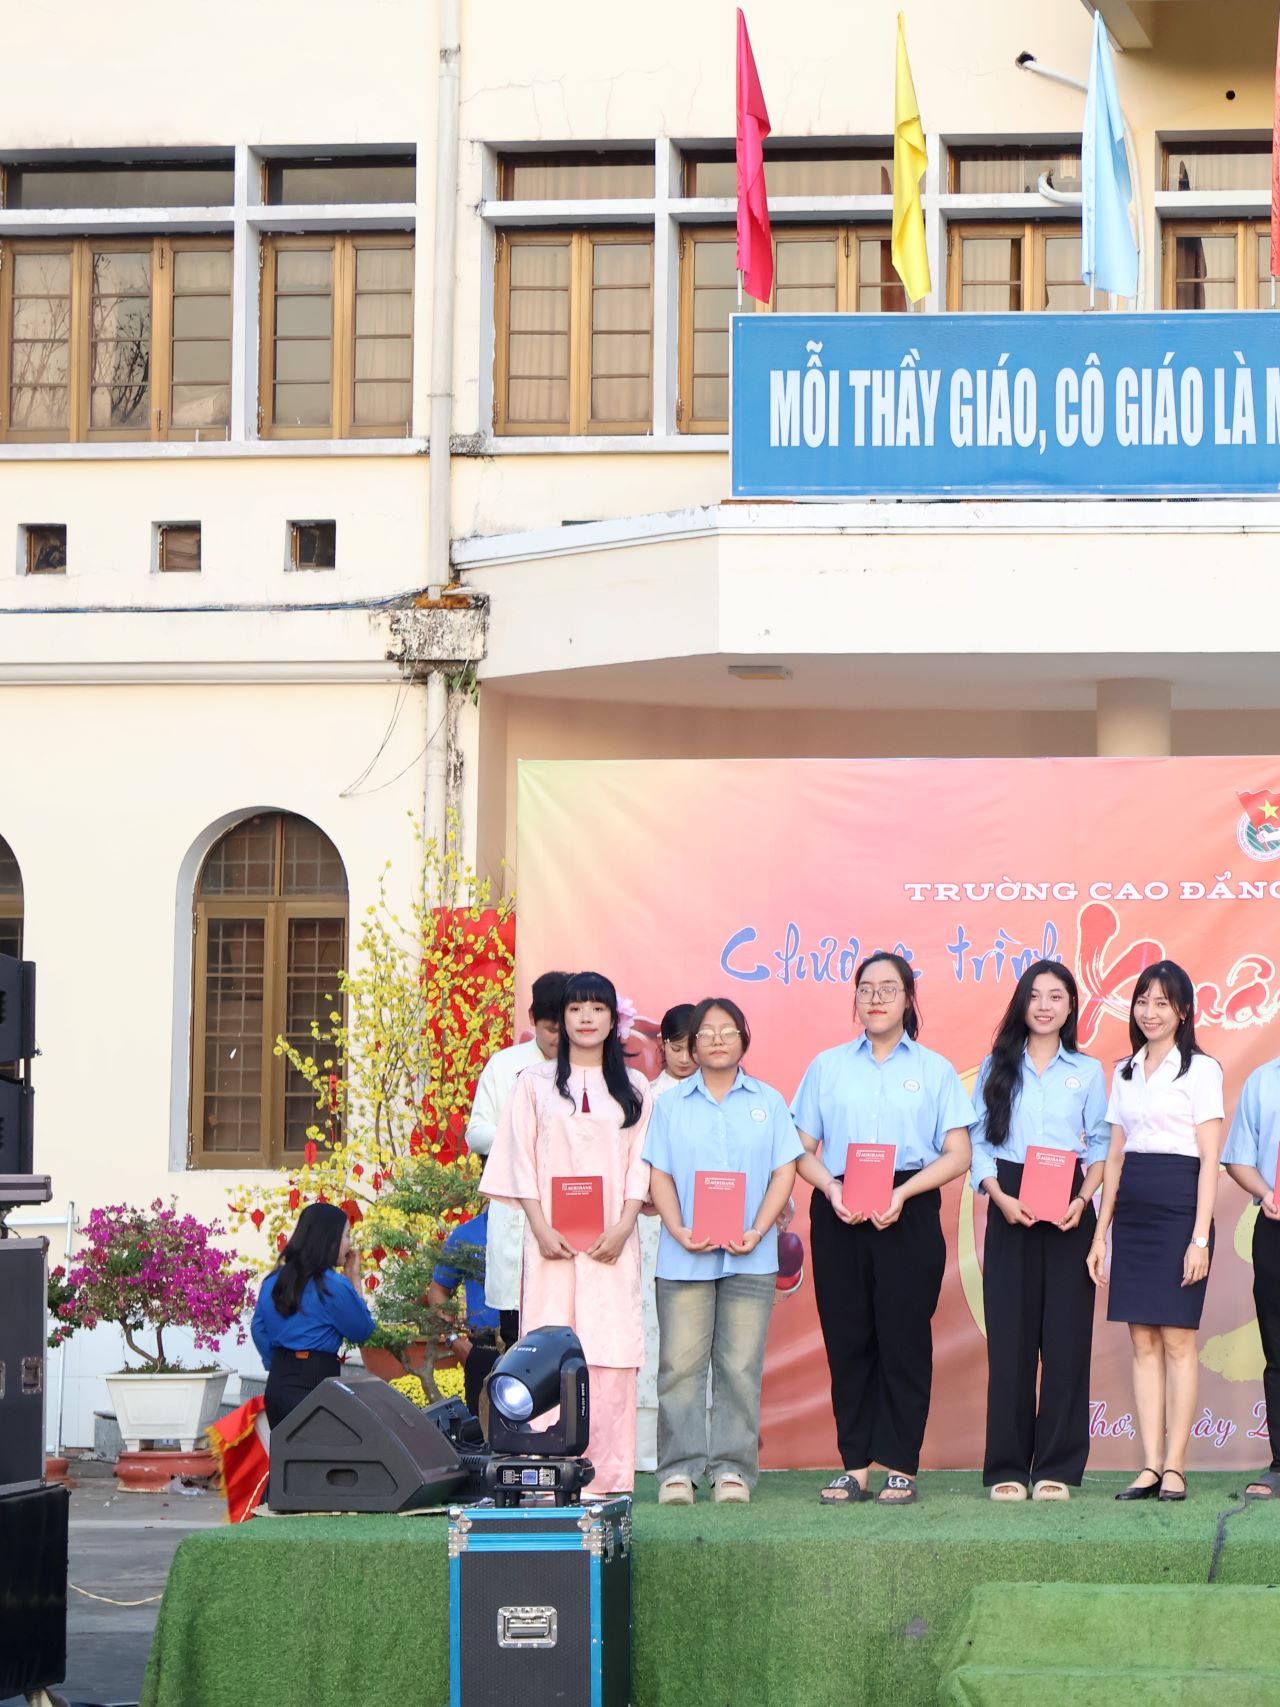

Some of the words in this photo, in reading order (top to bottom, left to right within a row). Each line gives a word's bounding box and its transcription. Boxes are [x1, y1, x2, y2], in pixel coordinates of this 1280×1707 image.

[770, 341, 841, 449] MỖI
[850, 349, 942, 447] THẦY
[950, 354, 1047, 454] GIÁO,
[1056, 353, 1105, 448] CÔ
[1116, 353, 1205, 447] GIÁO
[1214, 352, 1257, 446] LÀ
[904, 876, 1079, 901] TRƯỜNG
[1088, 881, 1170, 900] CAO
